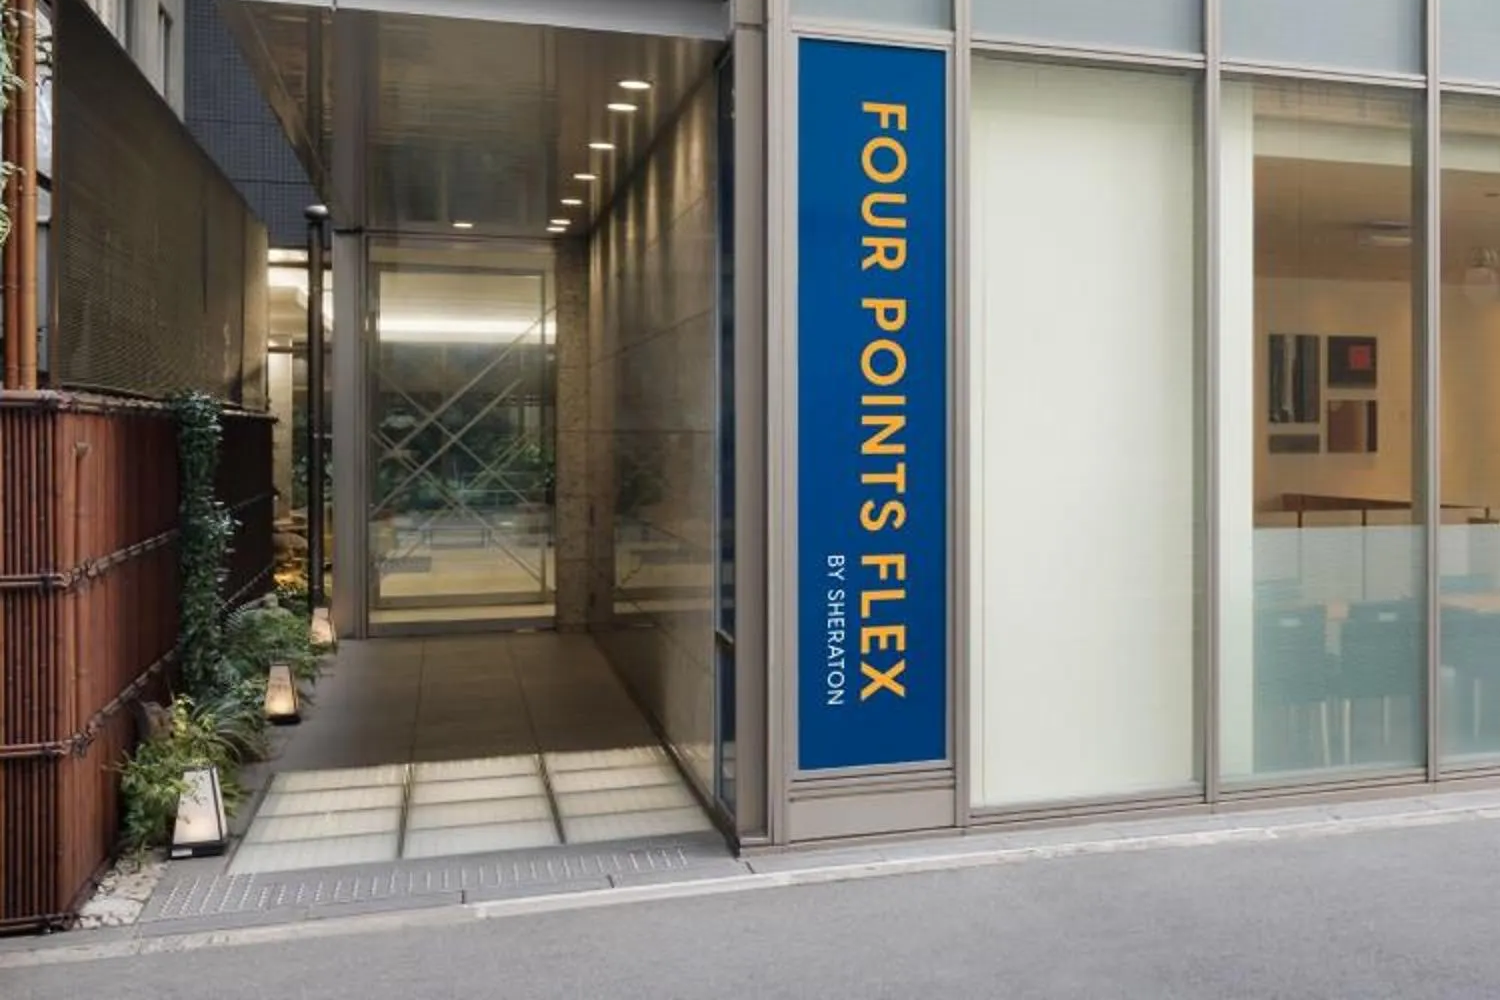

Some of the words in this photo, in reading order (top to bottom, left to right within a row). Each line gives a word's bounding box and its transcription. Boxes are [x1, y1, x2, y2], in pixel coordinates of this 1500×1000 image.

[861, 101, 908, 271] FOUR
[860, 297, 908, 532] POINTS
[827, 555, 846, 581] BY
[860, 553, 907, 701] FLEX
[827, 589, 846, 706] SHERATON
